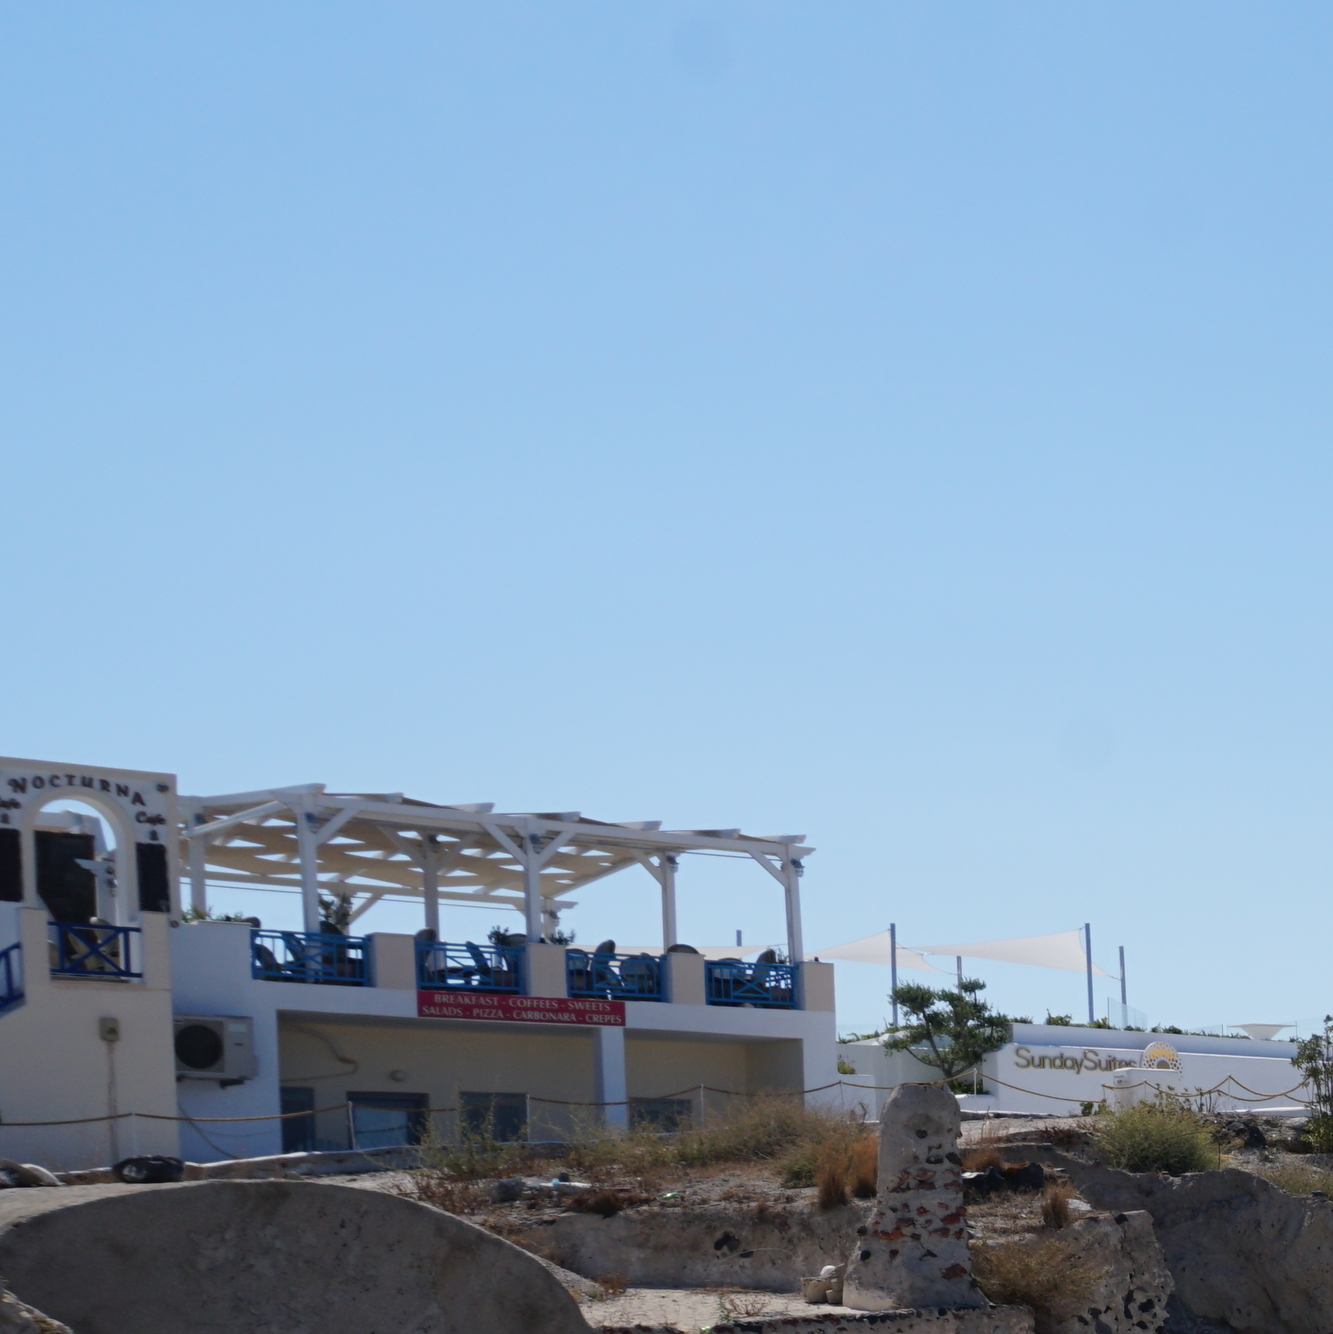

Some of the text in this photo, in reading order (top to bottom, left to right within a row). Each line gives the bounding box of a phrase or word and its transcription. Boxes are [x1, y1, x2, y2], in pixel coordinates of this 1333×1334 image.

[8, 774, 146, 807] NOCTURNA
[433, 993, 499, 1006] BREAKFAST
[508, 998, 559, 1010] COFFEES
[567, 1001, 611, 1012] SWEETS
[422, 1005, 463, 1017] SALADS
[472, 1008, 504, 1019] PIZZA
[512, 1010, 577, 1022] CARBONARA
[585, 1013, 622, 1024] CREPES
